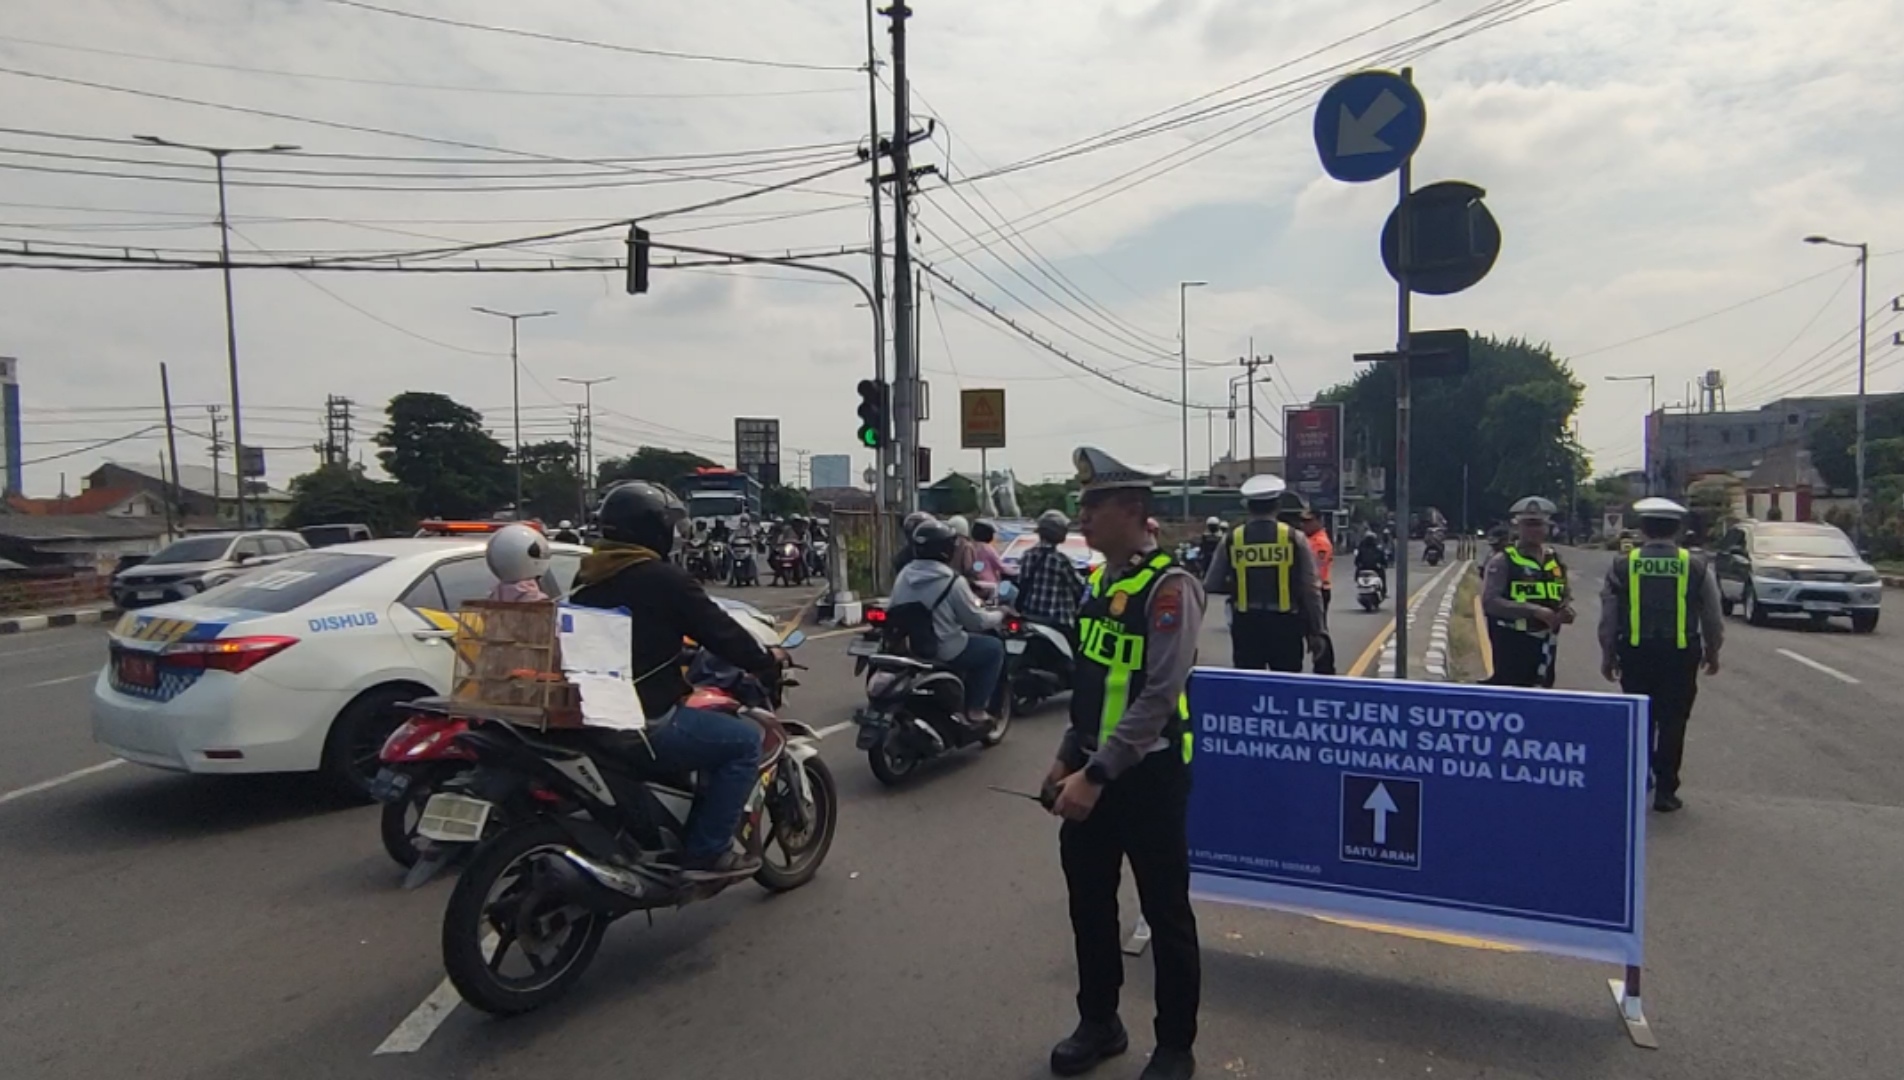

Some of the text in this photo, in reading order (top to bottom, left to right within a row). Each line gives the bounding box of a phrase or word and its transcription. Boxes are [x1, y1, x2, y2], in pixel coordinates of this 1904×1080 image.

[1235, 547, 1289, 563] POLISI
[1634, 560, 1684, 575] POLISI
[308, 611, 379, 632] DISHUB
[1252, 695, 1525, 733] JL. LETJEN SUTOYO
[1202, 713, 1586, 764] DIBERLAKUKAN SATU ARAH
[1202, 736, 1585, 788] SILAHKAN GUNAKAN DUA LAJUR
[1345, 845, 1415, 862] SATU ARAH
